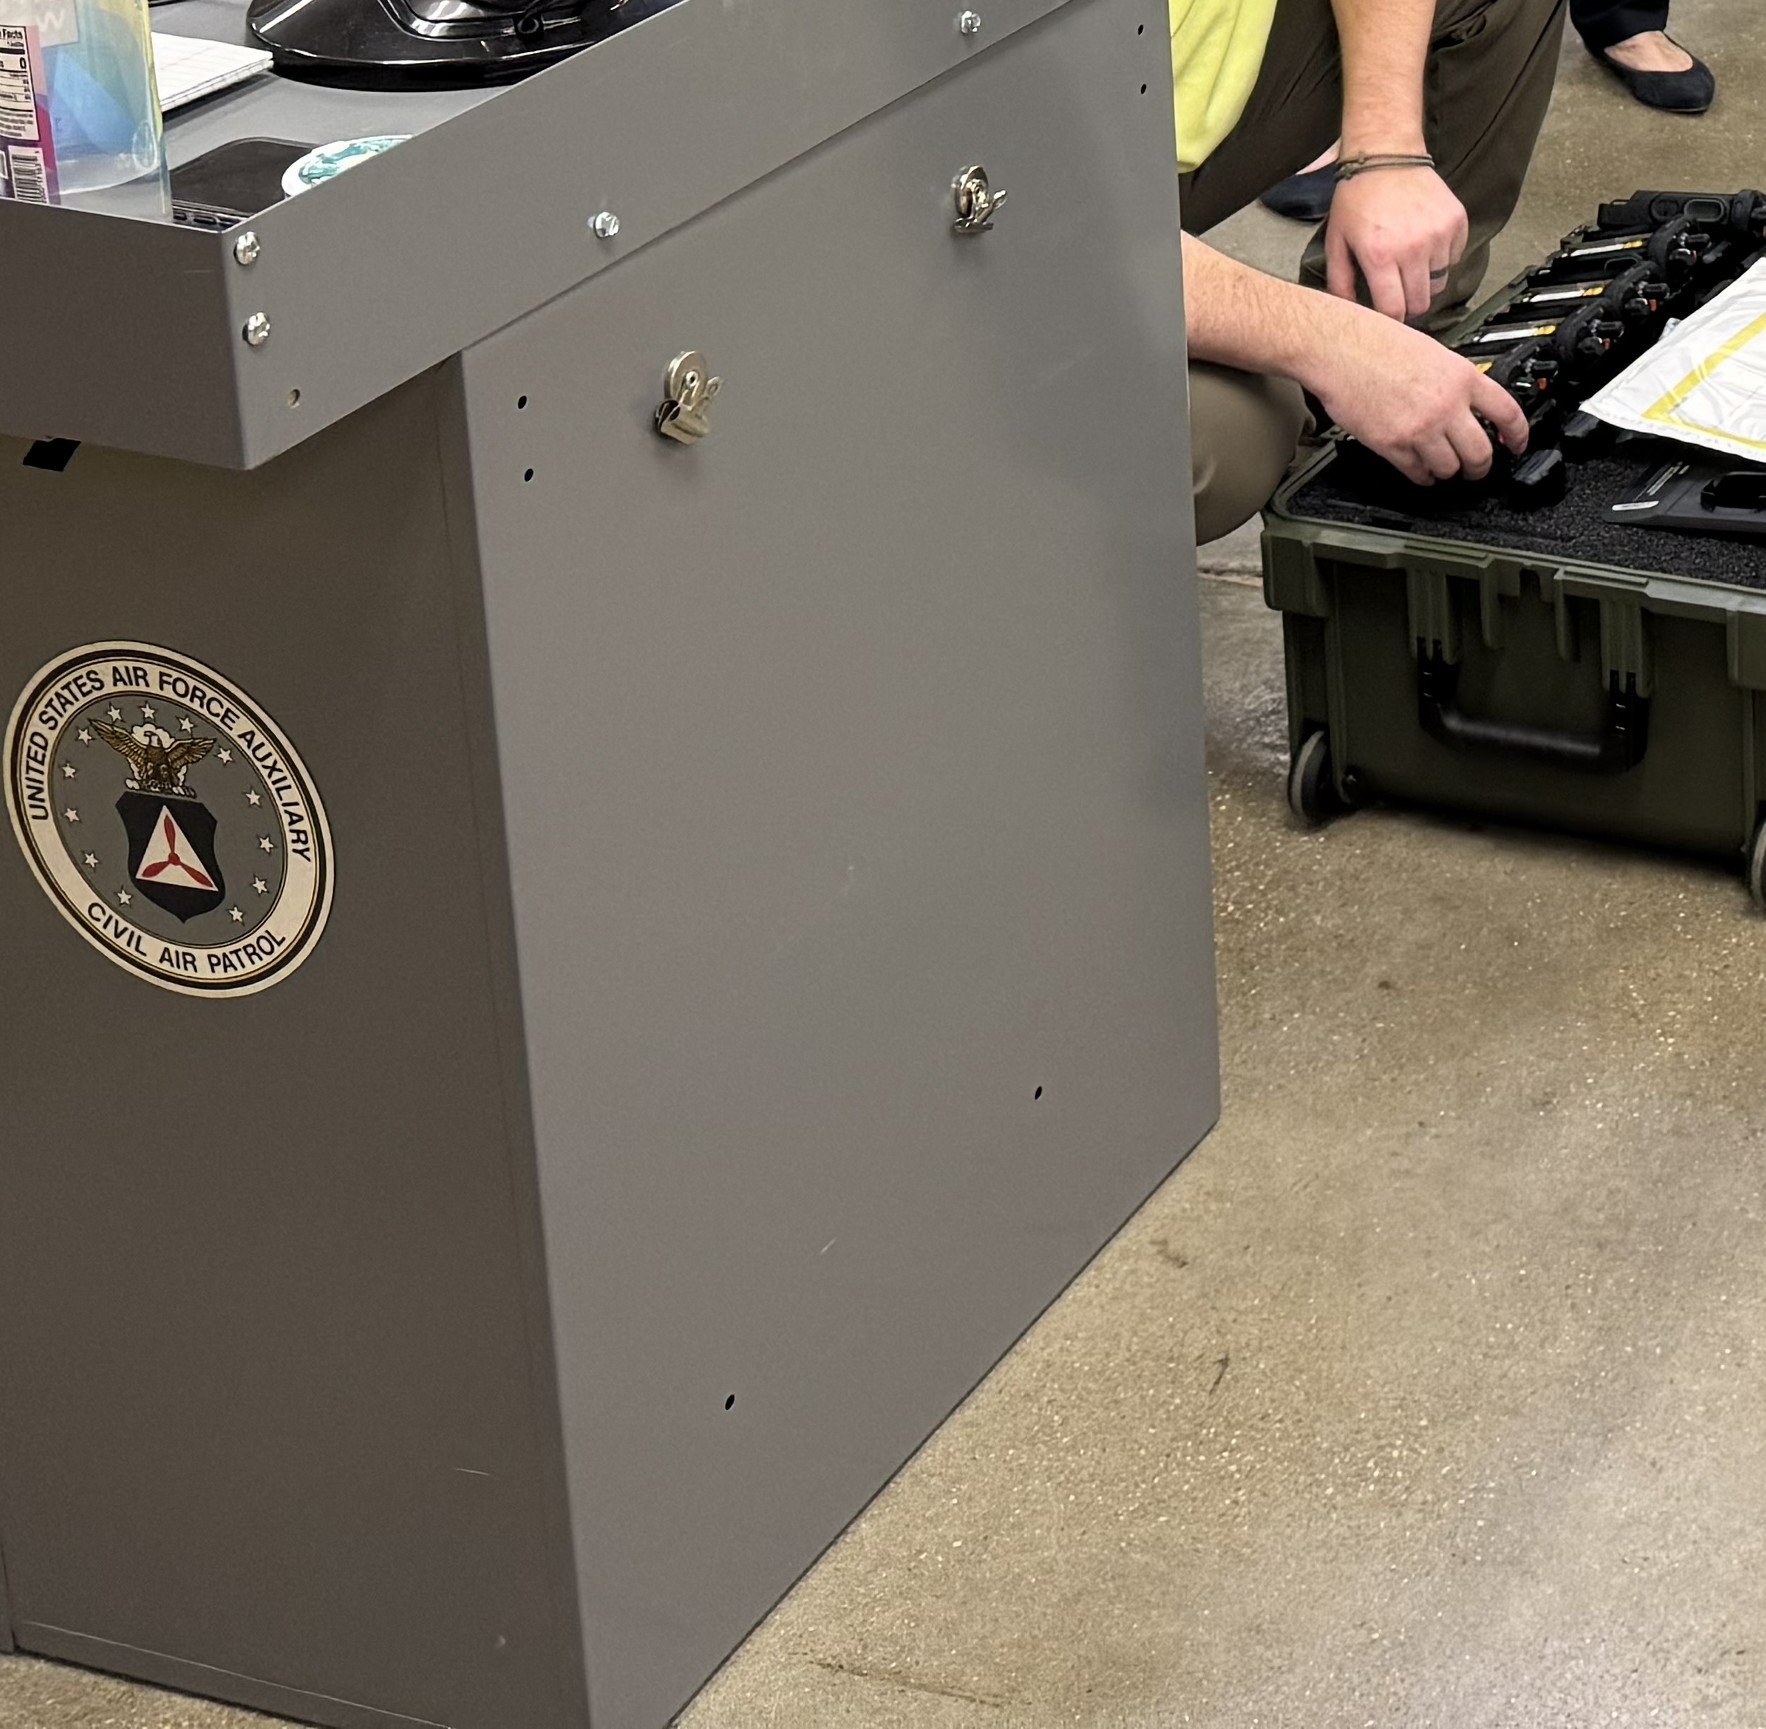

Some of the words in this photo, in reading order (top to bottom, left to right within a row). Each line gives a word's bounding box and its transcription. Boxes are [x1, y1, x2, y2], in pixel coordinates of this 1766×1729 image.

[19, 57, 27, 69] 0
[25, 733, 51, 821] UNITED
[38, 669, 105, 731] STATES
[112, 665, 150, 689] AIR
[158, 671, 240, 731] FORCE
[237, 729, 311, 862] AUXILIARY
[87, 901, 147, 957] CIVIL
[159, 946, 197, 974] AIR
[206, 930, 286, 975] PATROL
